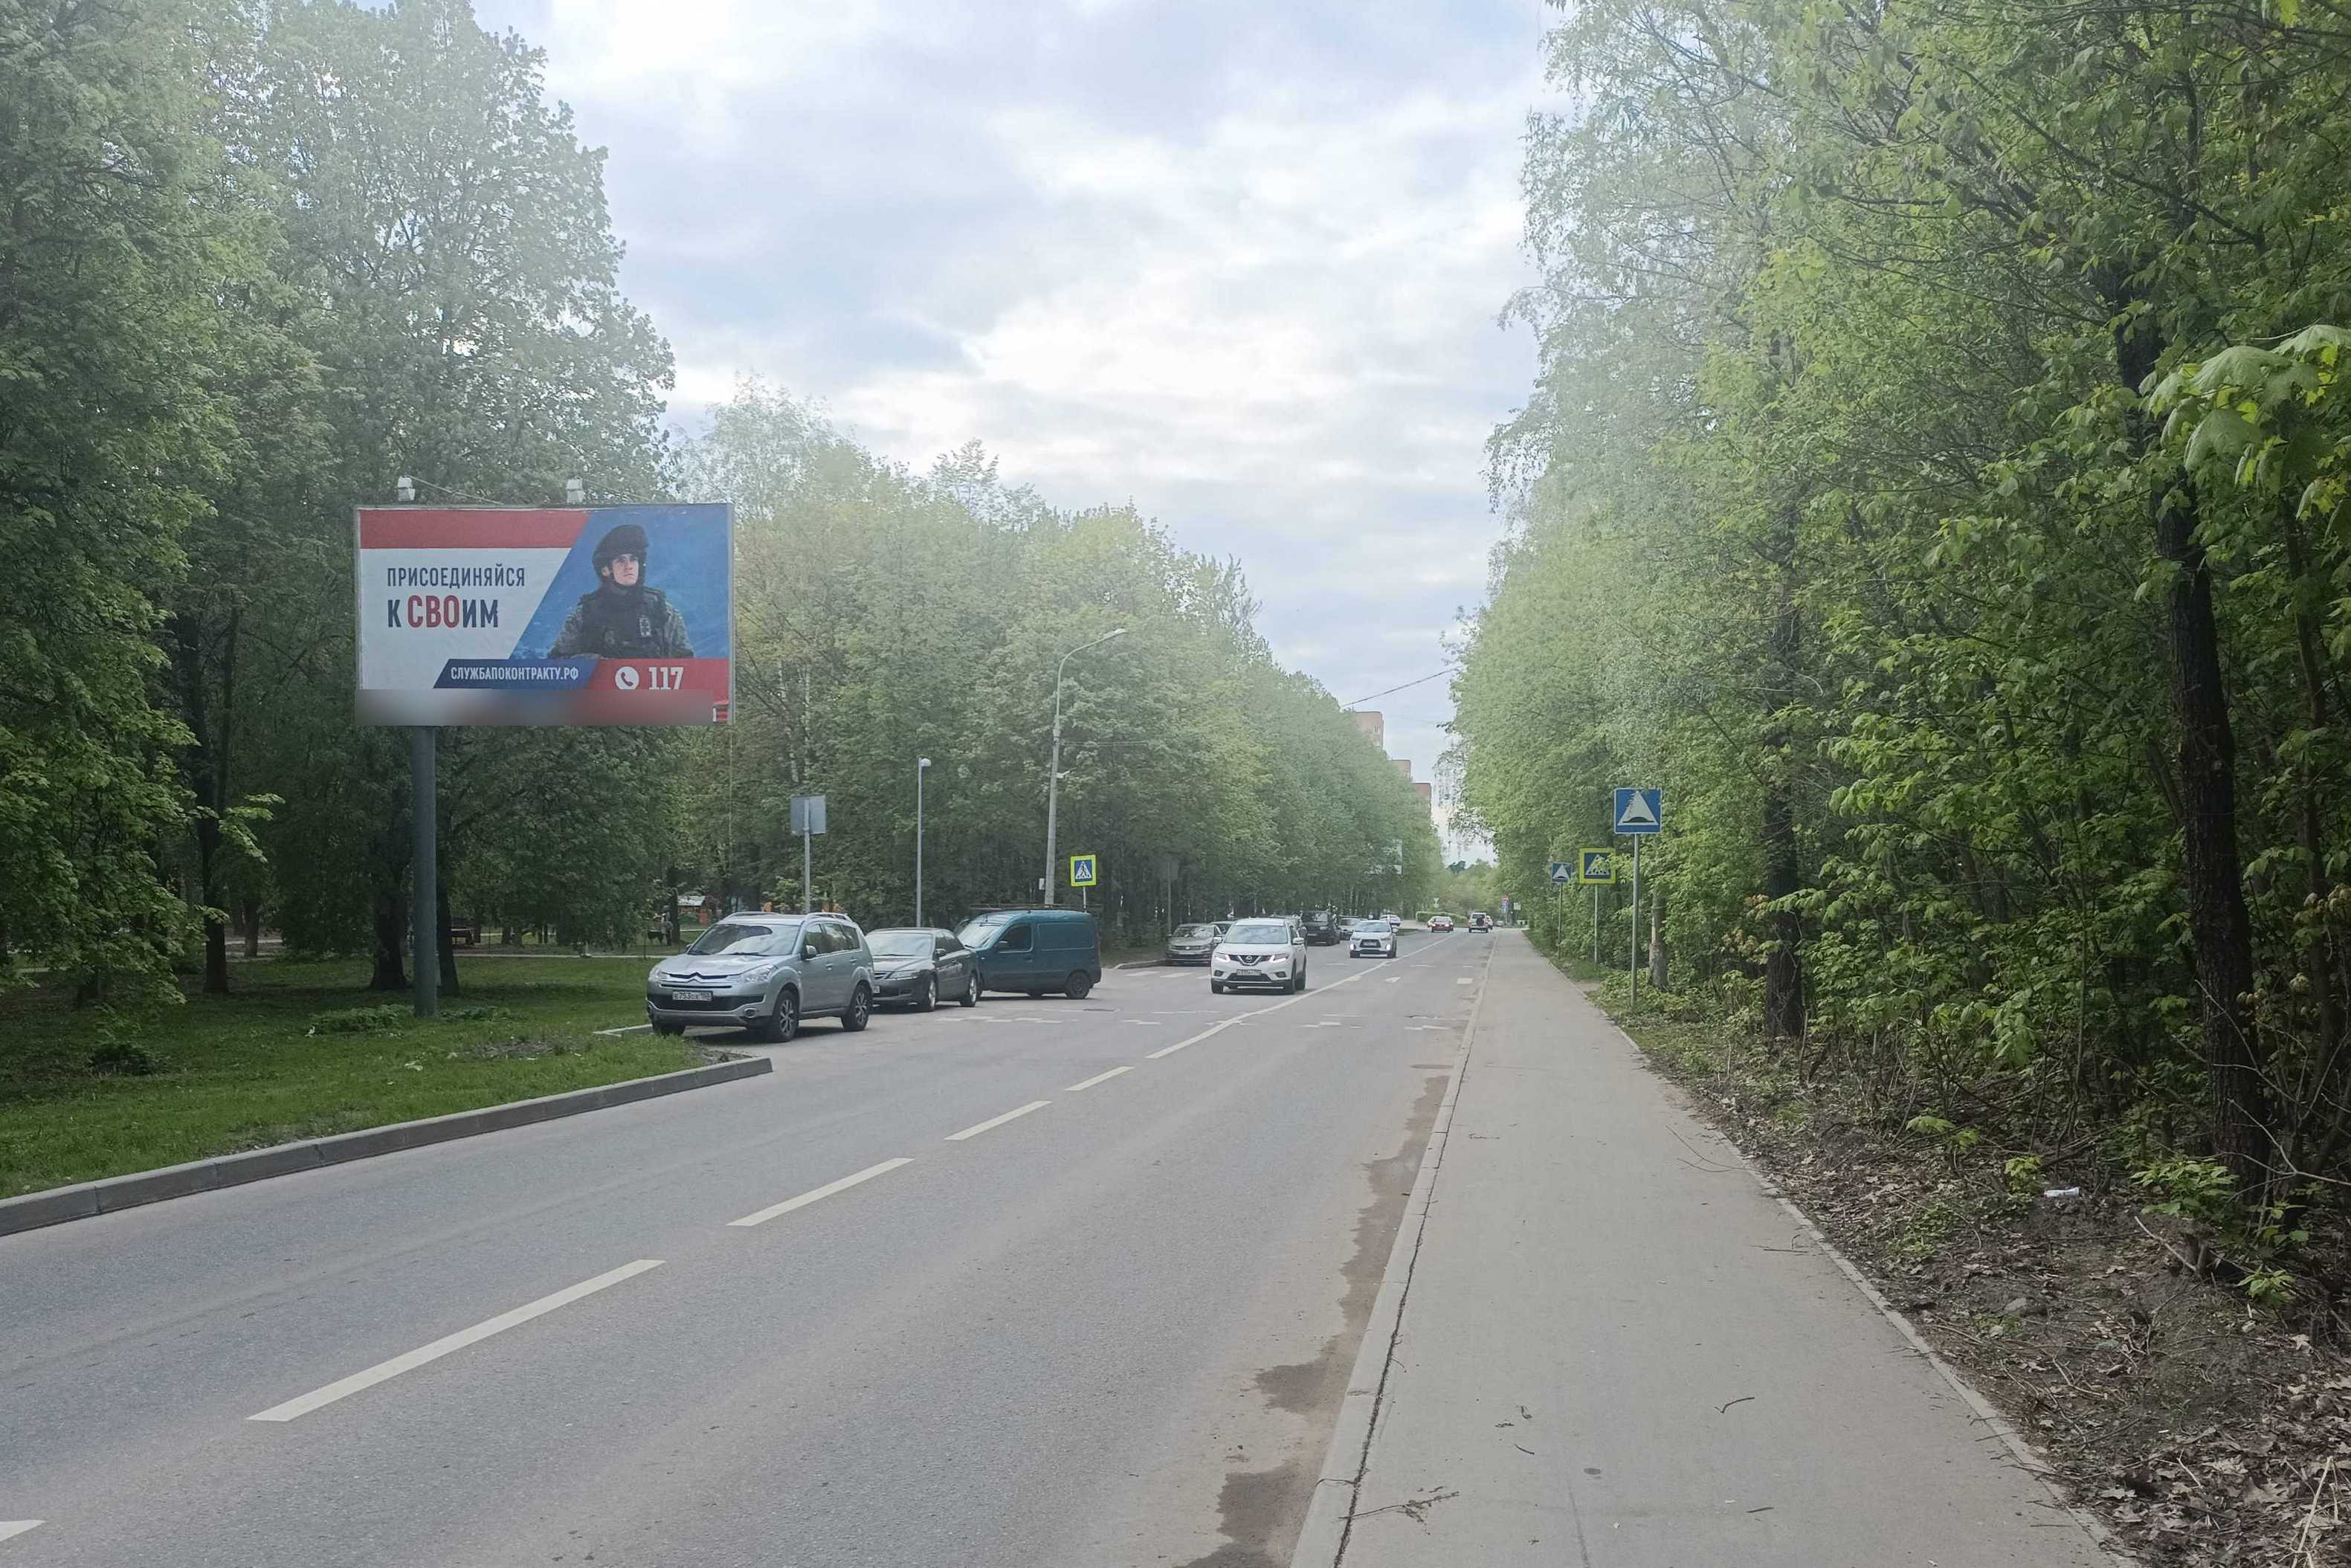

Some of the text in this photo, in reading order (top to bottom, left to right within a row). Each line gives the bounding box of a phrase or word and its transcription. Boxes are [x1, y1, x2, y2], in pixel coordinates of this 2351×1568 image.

[387, 563, 525, 589] ПРИСОЕДИНЯЙСЯ
[451, 666, 578, 681] СЛУЖБАПОКОНТРАКТУ.РФ
[648, 666, 683, 690] 117
